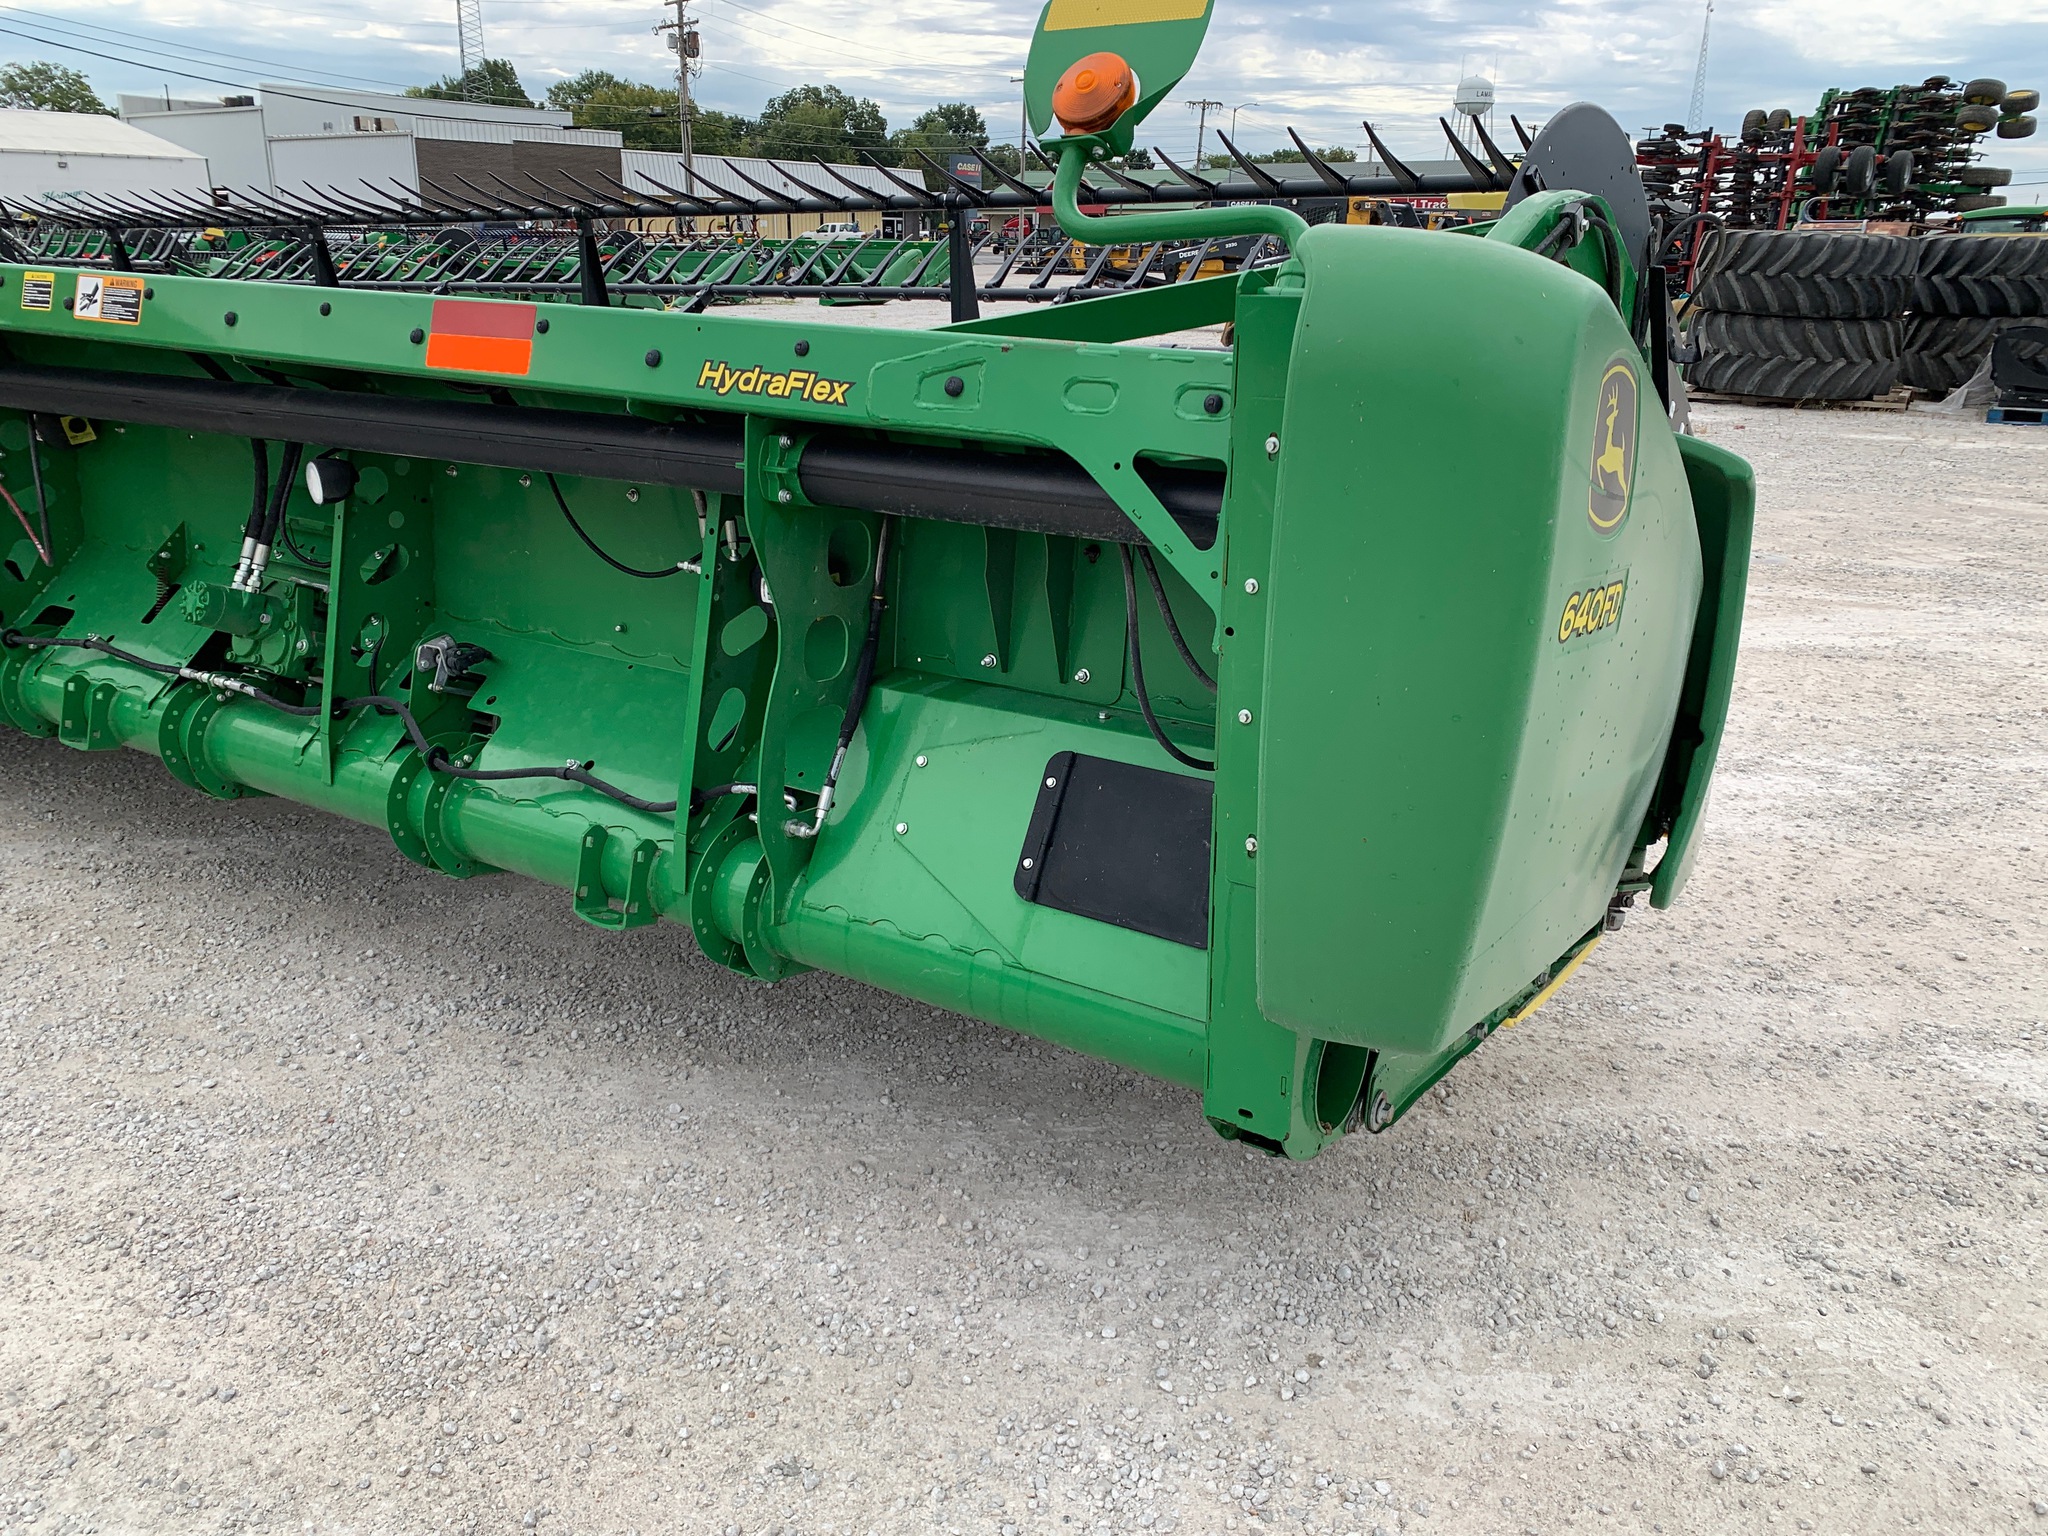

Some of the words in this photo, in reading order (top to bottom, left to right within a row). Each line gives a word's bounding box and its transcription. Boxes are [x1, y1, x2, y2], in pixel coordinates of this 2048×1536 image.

[957, 162, 976, 171] CASE
[1420, 199, 1450, 209] Trac
[115, 278, 138, 289] WARNING
[697, 360, 855, 406] HydraFlex
[1558, 580, 1623, 644] 640FD
